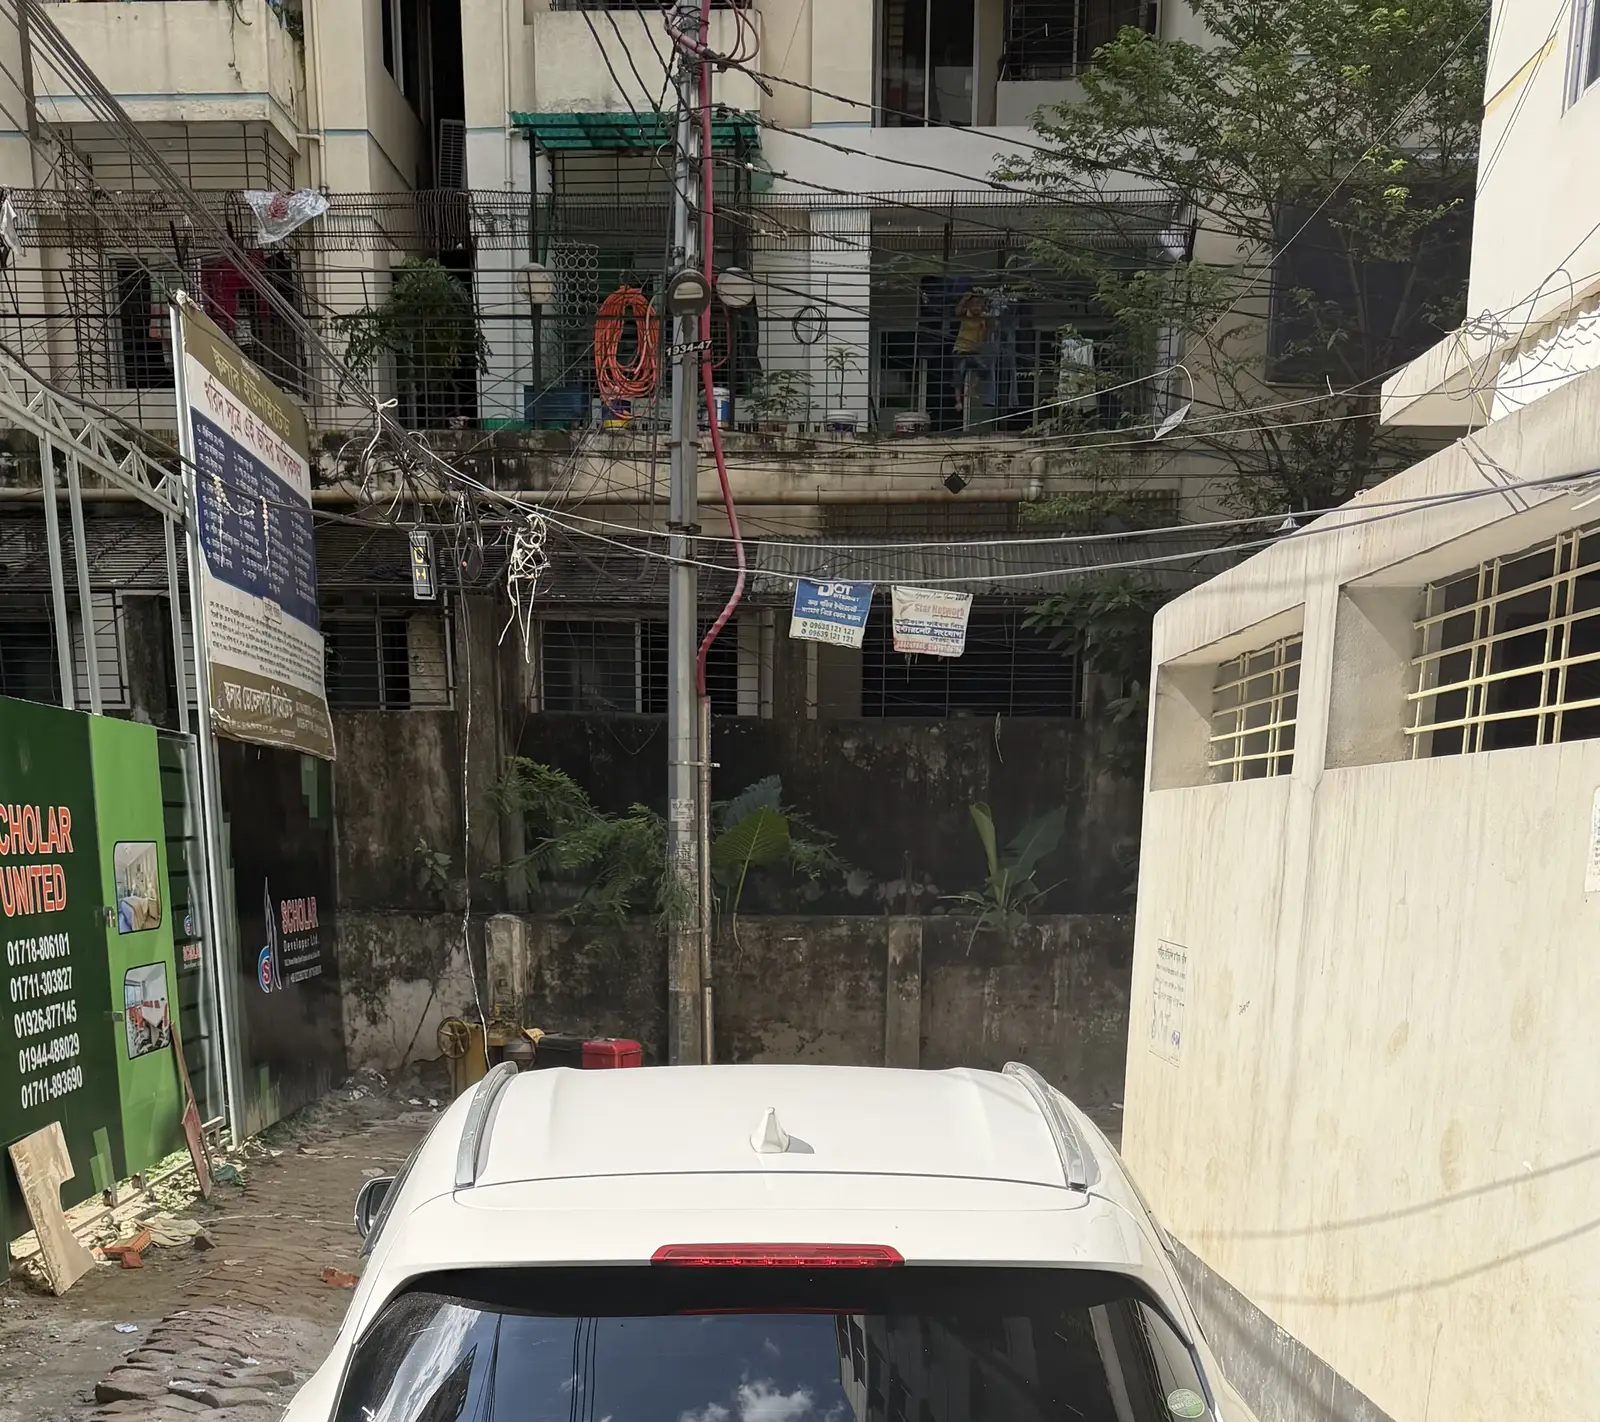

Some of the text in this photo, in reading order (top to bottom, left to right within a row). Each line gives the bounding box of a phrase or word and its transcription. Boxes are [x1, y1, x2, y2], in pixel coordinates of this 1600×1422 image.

[666, 340, 712, 356] 1934-47
[914, 603, 931, 613] Star
[0, 864, 67, 917] UNITED
[281, 896, 319, 934] SCHOLAR
[7, 932, 71, 967] 01718-806101
[284, 937, 310, 953] Developer
[10, 966, 73, 1003] 01711-303827
[14, 999, 77, 1038] 01926-877145
[19, 1032, 80, 1075] 01944-488029
[21, 1065, 83, 1109] 01711-893690
